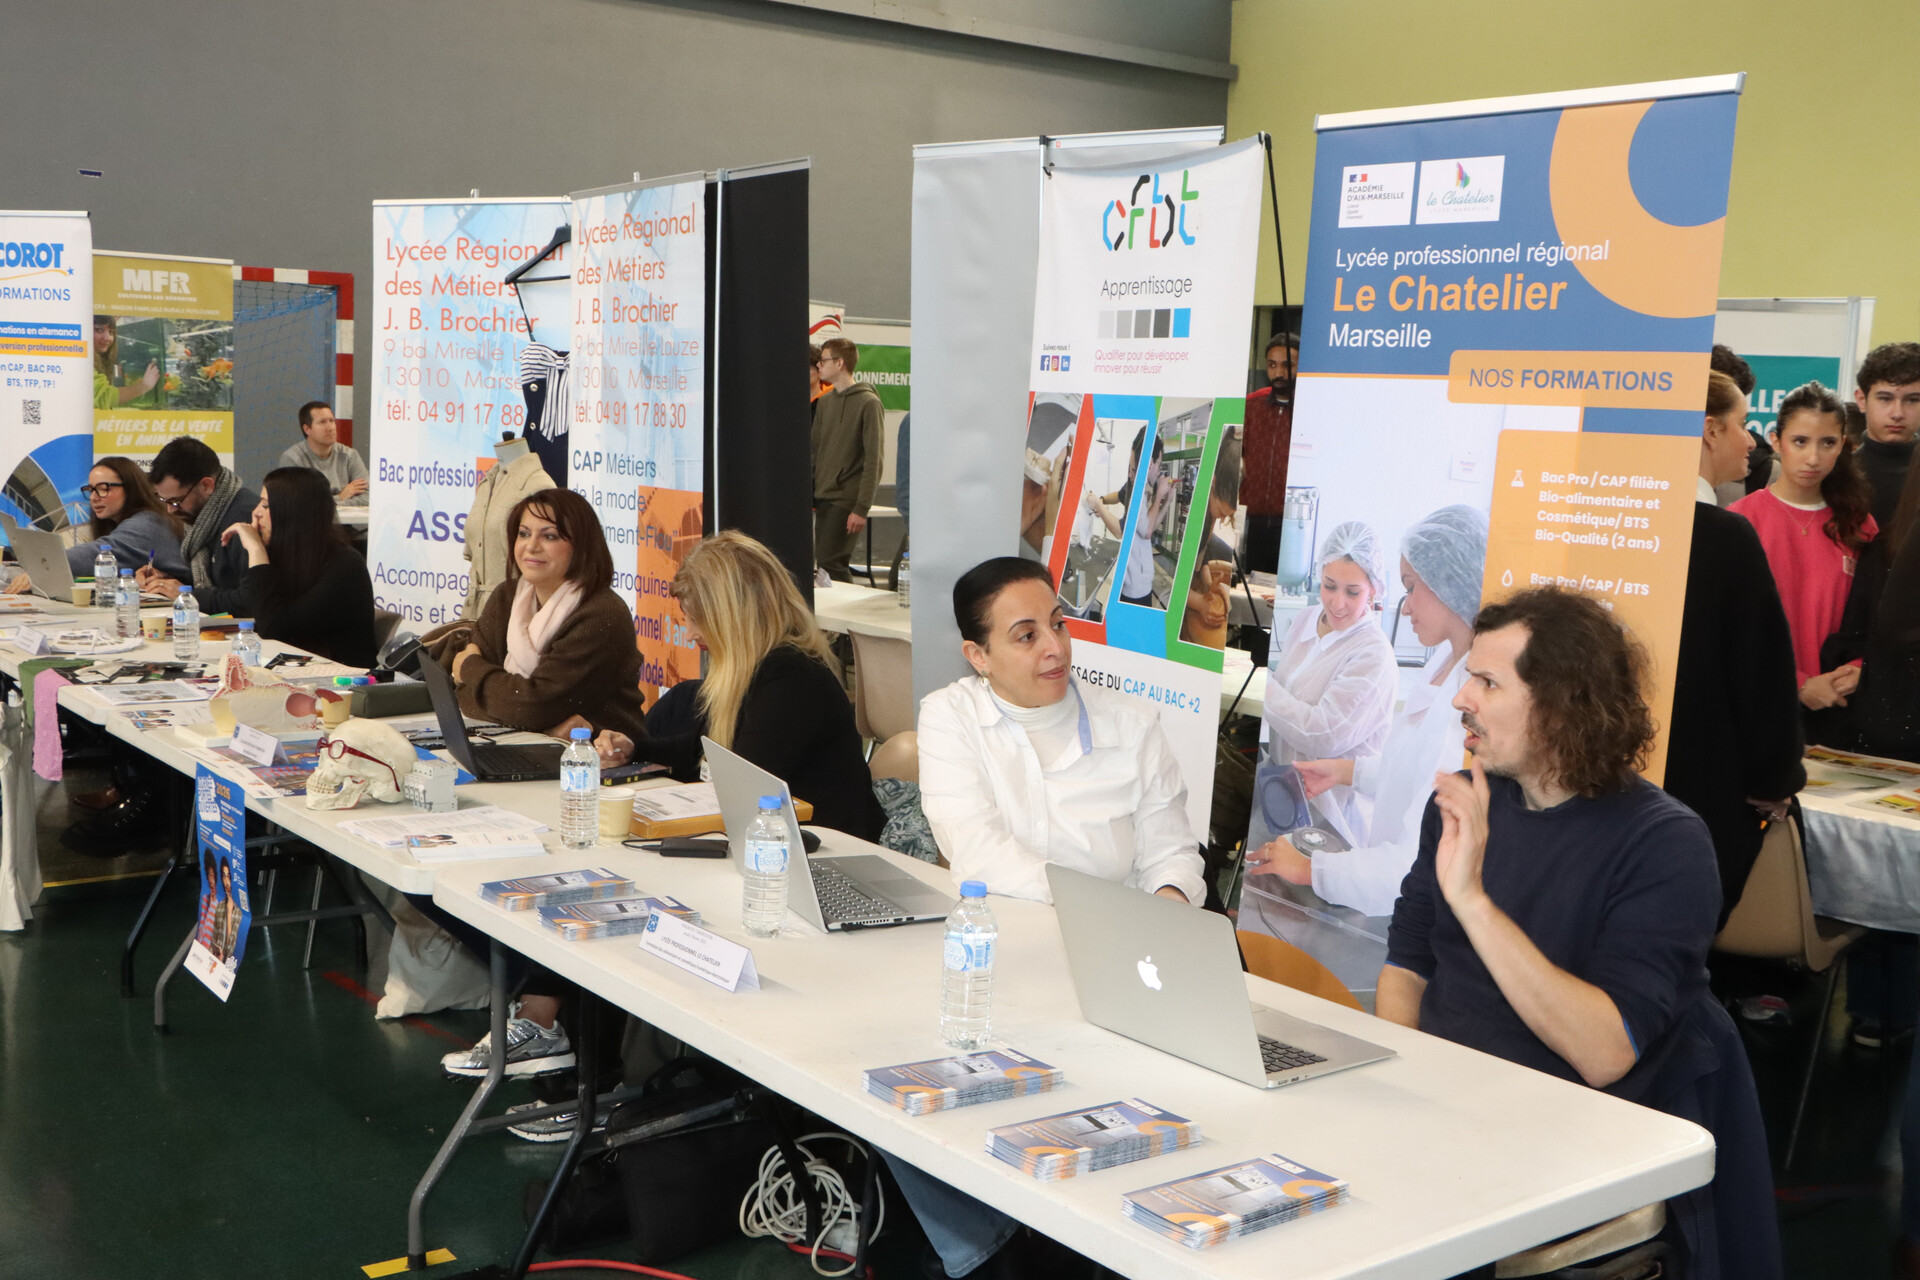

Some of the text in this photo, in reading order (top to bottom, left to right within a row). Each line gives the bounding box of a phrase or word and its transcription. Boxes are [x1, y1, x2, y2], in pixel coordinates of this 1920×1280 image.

[1346, 191, 1405, 202] D'AIX-MARSEILLE
[1347, 184, 1384, 193] ACADÉMIE
[1441, 189, 1495, 206] Chatelier
[579, 202, 696, 248] Lycée Régional
[0, 241, 64, 269] OROT
[386, 237, 447, 267] Lycée
[1335, 240, 1609, 272] Lycée professionnel régional
[122, 268, 191, 294] MFR
[384, 270, 518, 297] des Métiers
[577, 257, 665, 285] des Métiers
[1100, 276, 1192, 300] Apprentissage
[1333, 272, 1567, 313] Le Chatelier
[383, 306, 540, 333] J. B. Brochier
[576, 296, 679, 325] J. B. Brochier
[26, 328, 37, 336] en
[38, 327, 79, 338] alternance
[575, 335, 583, 353] 9
[587, 333, 604, 357] bd
[609, 331, 657, 357] Mireille
[1328, 323, 1432, 348] Marseille
[27, 342, 84, 353] professionnelle
[383, 338, 396, 357] 9
[403, 338, 426, 359] bd
[434, 340, 504, 361] Mireille
[1095, 349, 1126, 361] Qualifier
[1127, 351, 1144, 361] pour
[7, 363, 26, 373] CAP,
[27, 364, 45, 373] BAC
[46, 365, 64, 375] PRO,
[386, 366, 450, 387] 13010
[575, 366, 688, 391] 13010 Marseille
[852, 371, 911, 386] ONNEMENT
[1094, 362, 1163, 375] innover pour réussir
[1469, 368, 1673, 392] NOS FORMATIONS
[7, 378, 23, 388] BTS,
[24, 379, 41, 389] TFP,
[96, 416, 224, 433] MÉTIERS DE LA VENTE
[387, 399, 525, 427] tél: 04 91 17 88
[575, 400, 686, 429] tél: 04 91 17 88 30
[379, 457, 404, 483] Bac
[573, 450, 657, 479] CAP Métiers
[1541, 471, 1670, 491] Bac Pro / CAP filière
[592, 485, 603, 506] la
[606, 490, 647, 513] mode
[1538, 490, 1661, 510] Bio-alimentaire et
[1537, 510, 1650, 530] Cosmétique/ BTS
[1535, 529, 1661, 554] Bio-Qualité (2 ans)
[1530, 573, 1554, 585] Bac
[1623, 582, 1650, 596] BTS
[429, 603, 446, 625] et
[664, 615, 671, 644] 3
[639, 657, 664, 687] ode
[1106, 674, 1121, 691] DU
[1123, 678, 1146, 697] CAP
[1148, 685, 1162, 702] AU
[1165, 688, 1186, 709] BAC
[1188, 697, 1200, 714] +2
